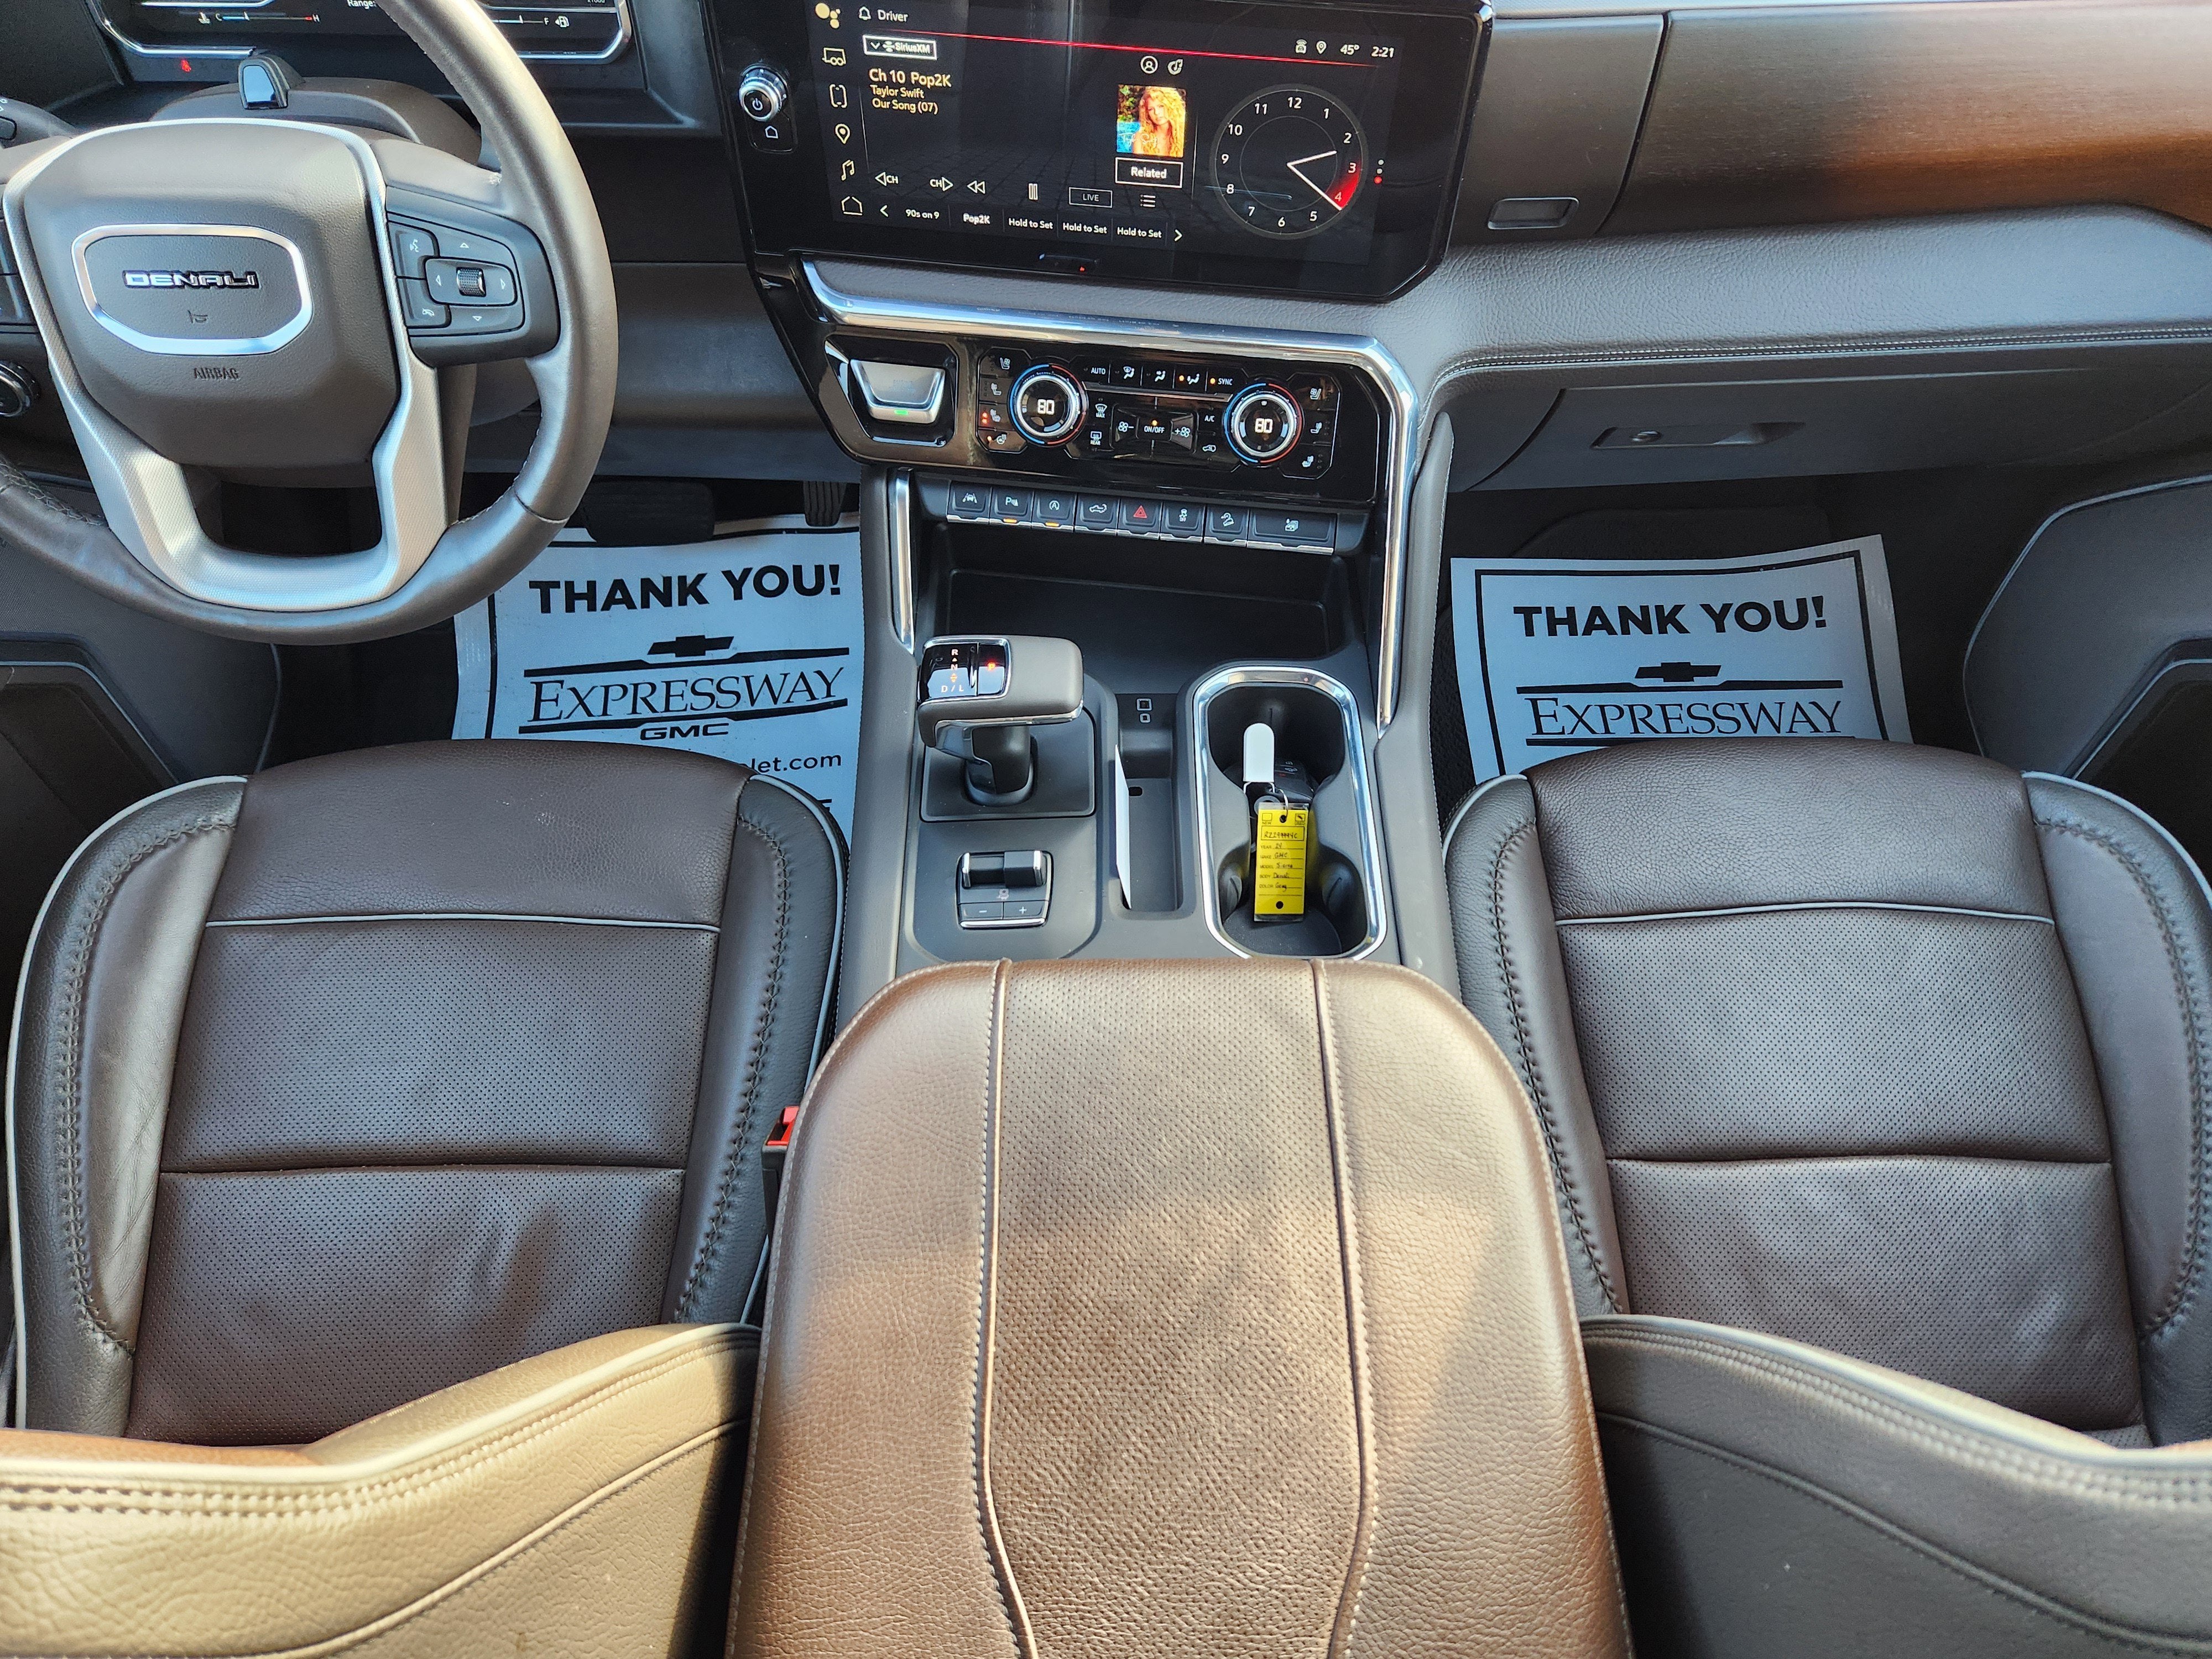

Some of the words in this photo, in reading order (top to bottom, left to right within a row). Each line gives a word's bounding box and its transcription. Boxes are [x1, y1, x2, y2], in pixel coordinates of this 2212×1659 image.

[544, 17, 550, 25] F
[878, 9, 909, 22] Driver
[895, 42, 931, 54] SiriusXM
[1371, 46, 1395, 58] 2:21
[869, 68, 887, 82] Ch
[889, 69, 906, 84] 10
[910, 72, 952, 89] Pop2K
[870, 84, 899, 98] Taylor
[900, 87, 925, 99] Swift
[872, 97, 890, 109] Our
[891, 99, 916, 114] Song
[917, 101, 939, 115] (07)
[1287, 96, 1302, 109] 12
[1254, 102, 1268, 116] 11
[1323, 108, 1330, 119] 1
[1228, 123, 1243, 136] 10
[1343, 132, 1353, 144] 2
[1220, 153, 1230, 165] 9
[1130, 166, 1168, 179] Related
[1348, 162, 1357, 174] 3
[886, 175, 899, 185] CH
[930, 179, 942, 188] CH
[1226, 183, 1235, 195] 8
[1082, 193, 1100, 202] LIVE
[1334, 191, 1343, 202] 4
[905, 208, 921, 218] 90s
[933, 211, 940, 220] 9
[1248, 206, 1256, 217] 7
[1309, 211, 1318, 222] 5
[963, 213, 991, 226] Pop2K
[1008, 217, 1028, 228] Hold
[1029, 220, 1039, 228] to
[1040, 220, 1053, 230] Set
[1277, 217, 1286, 227] 6
[1062, 222, 1082, 233] Hold
[1083, 225, 1093, 233] to
[1093, 225, 1108, 234] Set
[1117, 227, 1137, 237] Hold
[1138, 228, 1147, 237] to
[1148, 229, 1162, 238] Set
[123, 270, 259, 289] DENALI
[194, 367, 239, 380] AIRBAG
[1218, 377, 1233, 386] SYNC
[1037, 399, 1056, 416] 80
[1204, 414, 1215, 423] A/C
[1144, 425, 1165, 434] ON/OFF
[1254, 418, 1274, 434] 80
[529, 572, 710, 614] THANK
[722, 564, 842, 601] YOU!
[1513, 604, 1691, 638] THANK
[1700, 595, 1827, 633] YOU!
[987, 662, 996, 671] P
[527, 666, 845, 723] EXPRESSWAY
[1525, 697, 1843, 736] EXPRESSWAY
[640, 722, 731, 741] GMC
